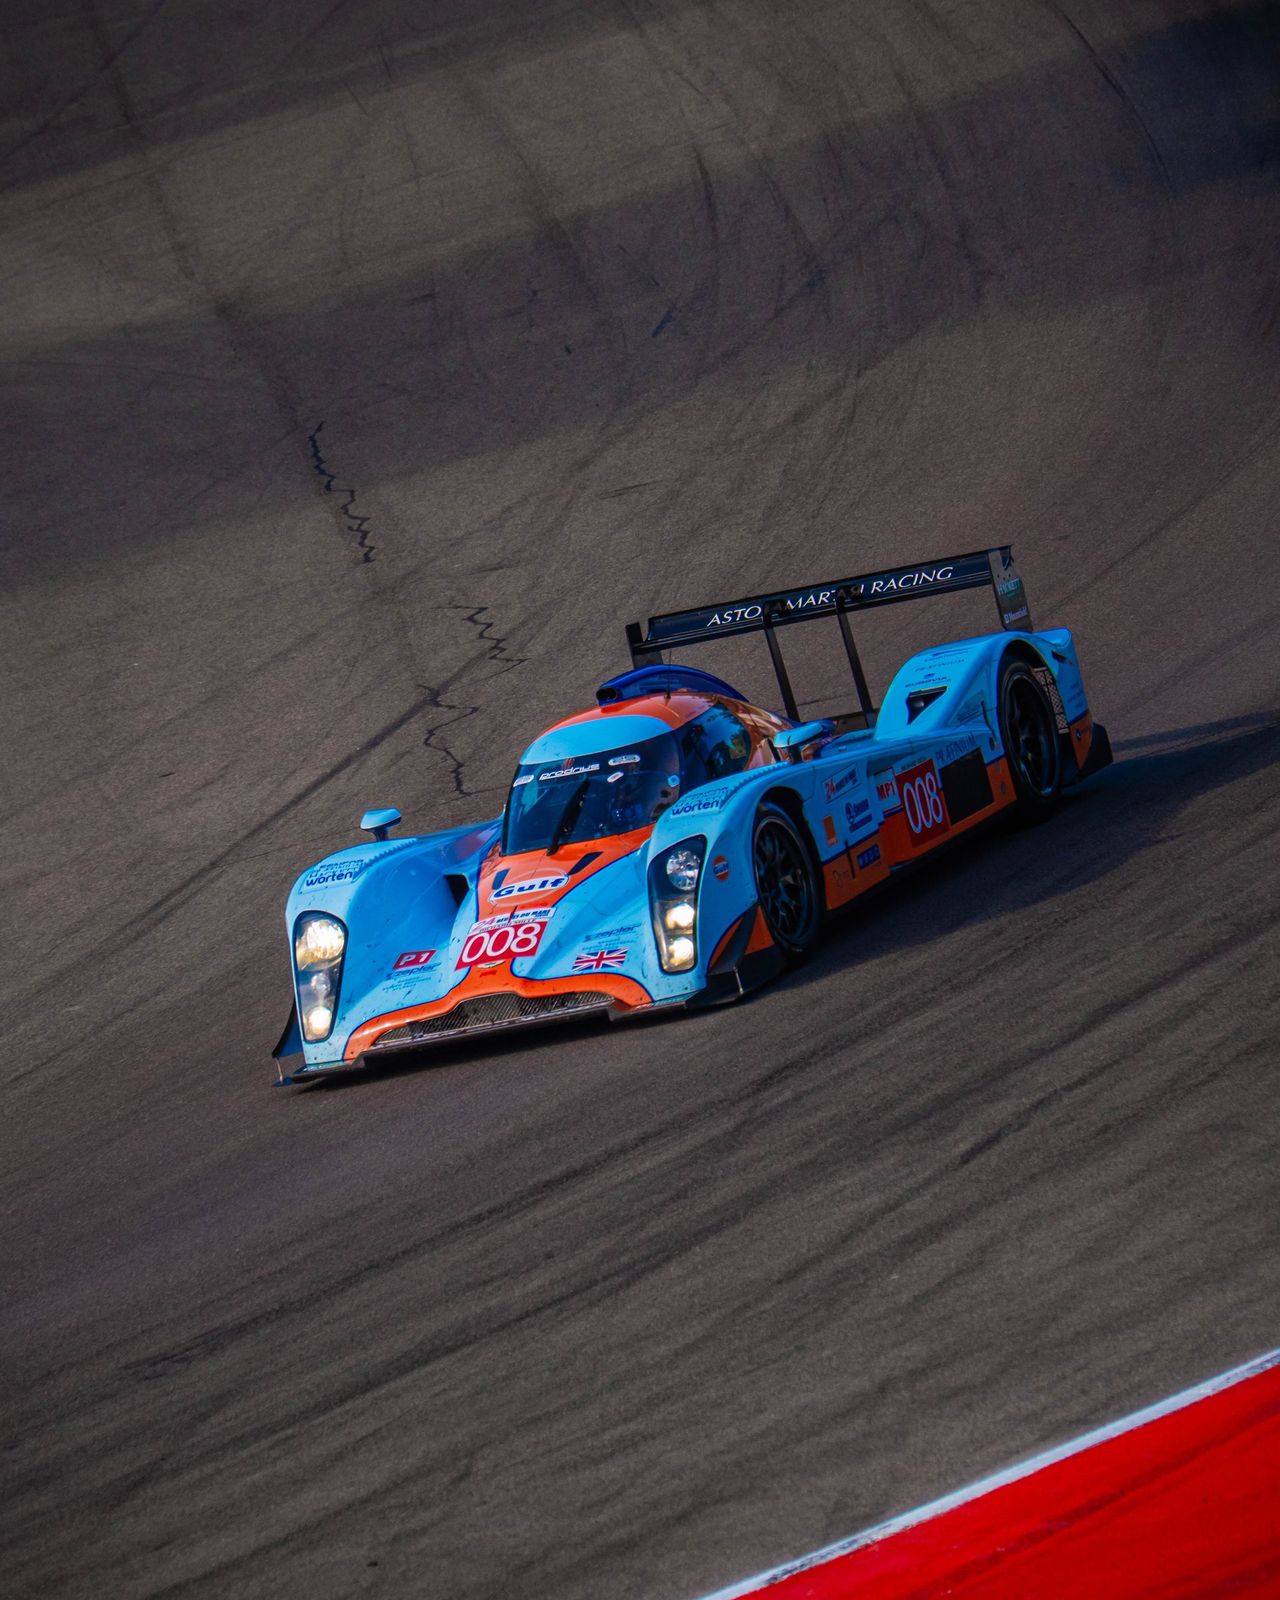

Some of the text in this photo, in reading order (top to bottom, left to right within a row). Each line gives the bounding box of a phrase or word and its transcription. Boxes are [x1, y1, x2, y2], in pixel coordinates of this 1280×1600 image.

[707, 600, 772, 627] ASTO
[870, 566, 954, 594] RACING
[539, 763, 600, 781] prodrive
[672, 799, 720, 816] worten
[903, 772, 943, 833] 008
[306, 871, 353, 887] worten
[493, 878, 565, 898] Gulf
[462, 923, 541, 963] 008
[399, 952, 430, 966] P1
